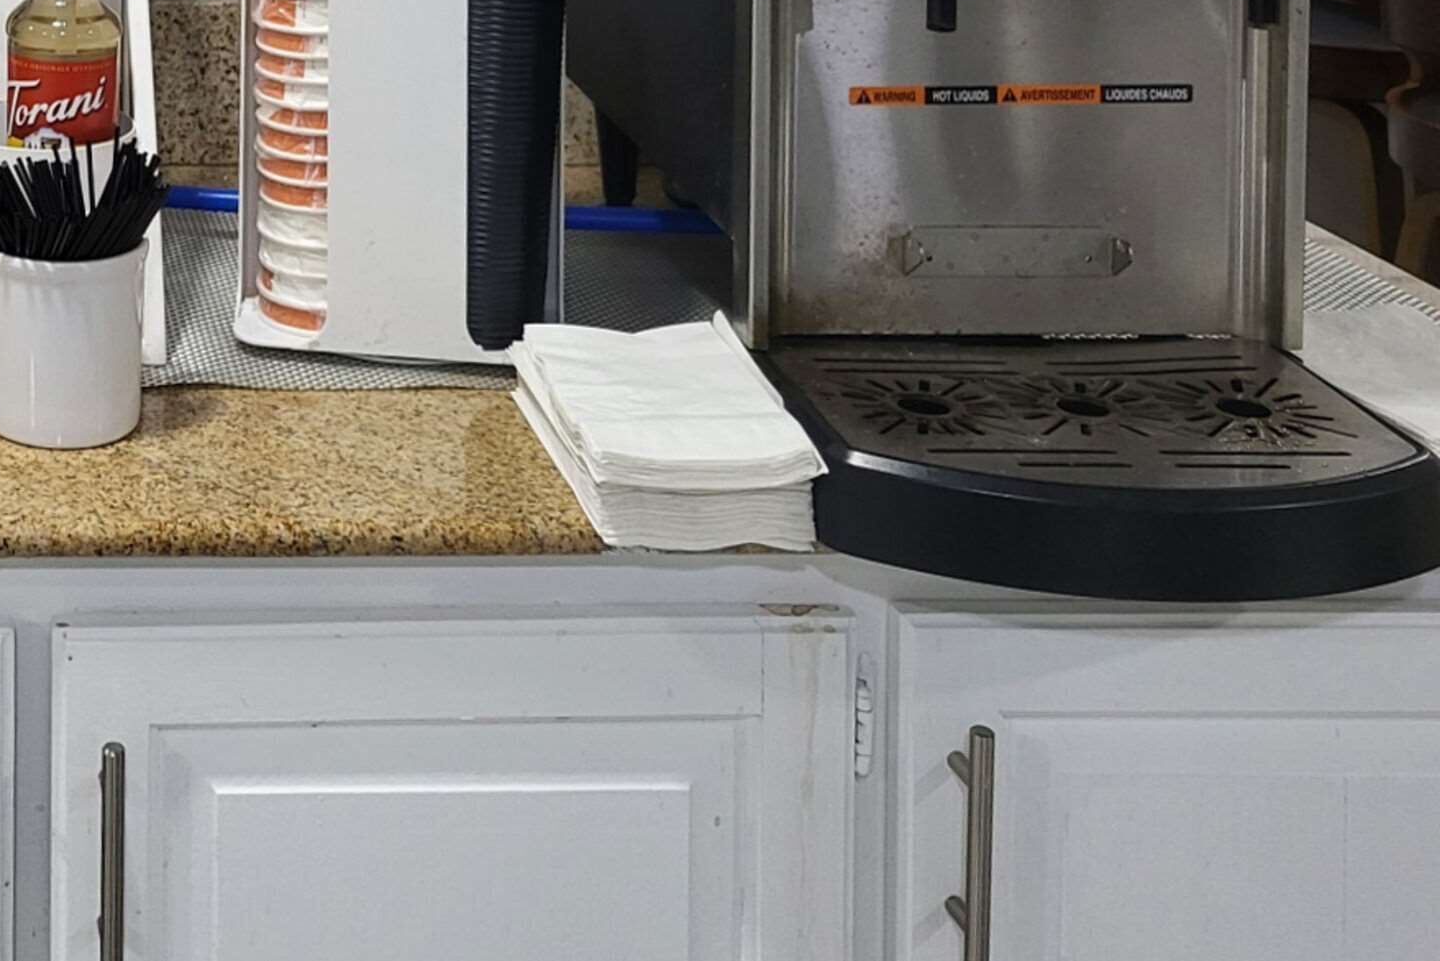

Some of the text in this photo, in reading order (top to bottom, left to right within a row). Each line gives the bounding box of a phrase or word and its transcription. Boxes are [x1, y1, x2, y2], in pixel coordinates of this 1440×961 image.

[8, 75, 107, 138] Torani
[932, 90, 952, 102] HOT
[953, 90, 990, 102] LIQUIDS
